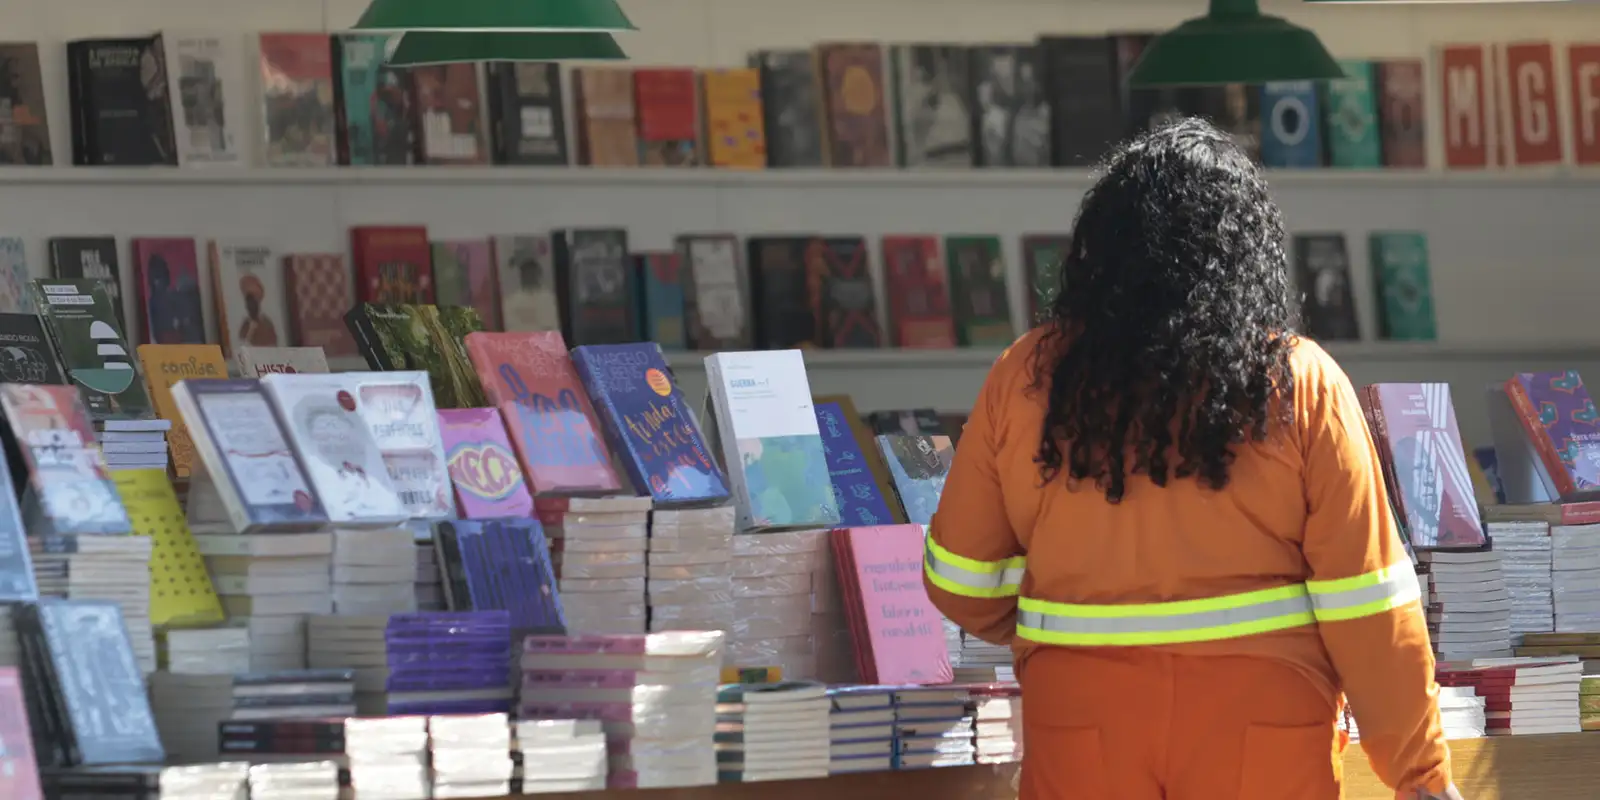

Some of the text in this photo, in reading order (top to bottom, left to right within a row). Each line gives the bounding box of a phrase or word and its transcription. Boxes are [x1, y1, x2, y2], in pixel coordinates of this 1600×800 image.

[1450, 64, 1480, 147] M
[1517, 61, 1549, 145] G
[588, 350, 649, 366] MARCELO
